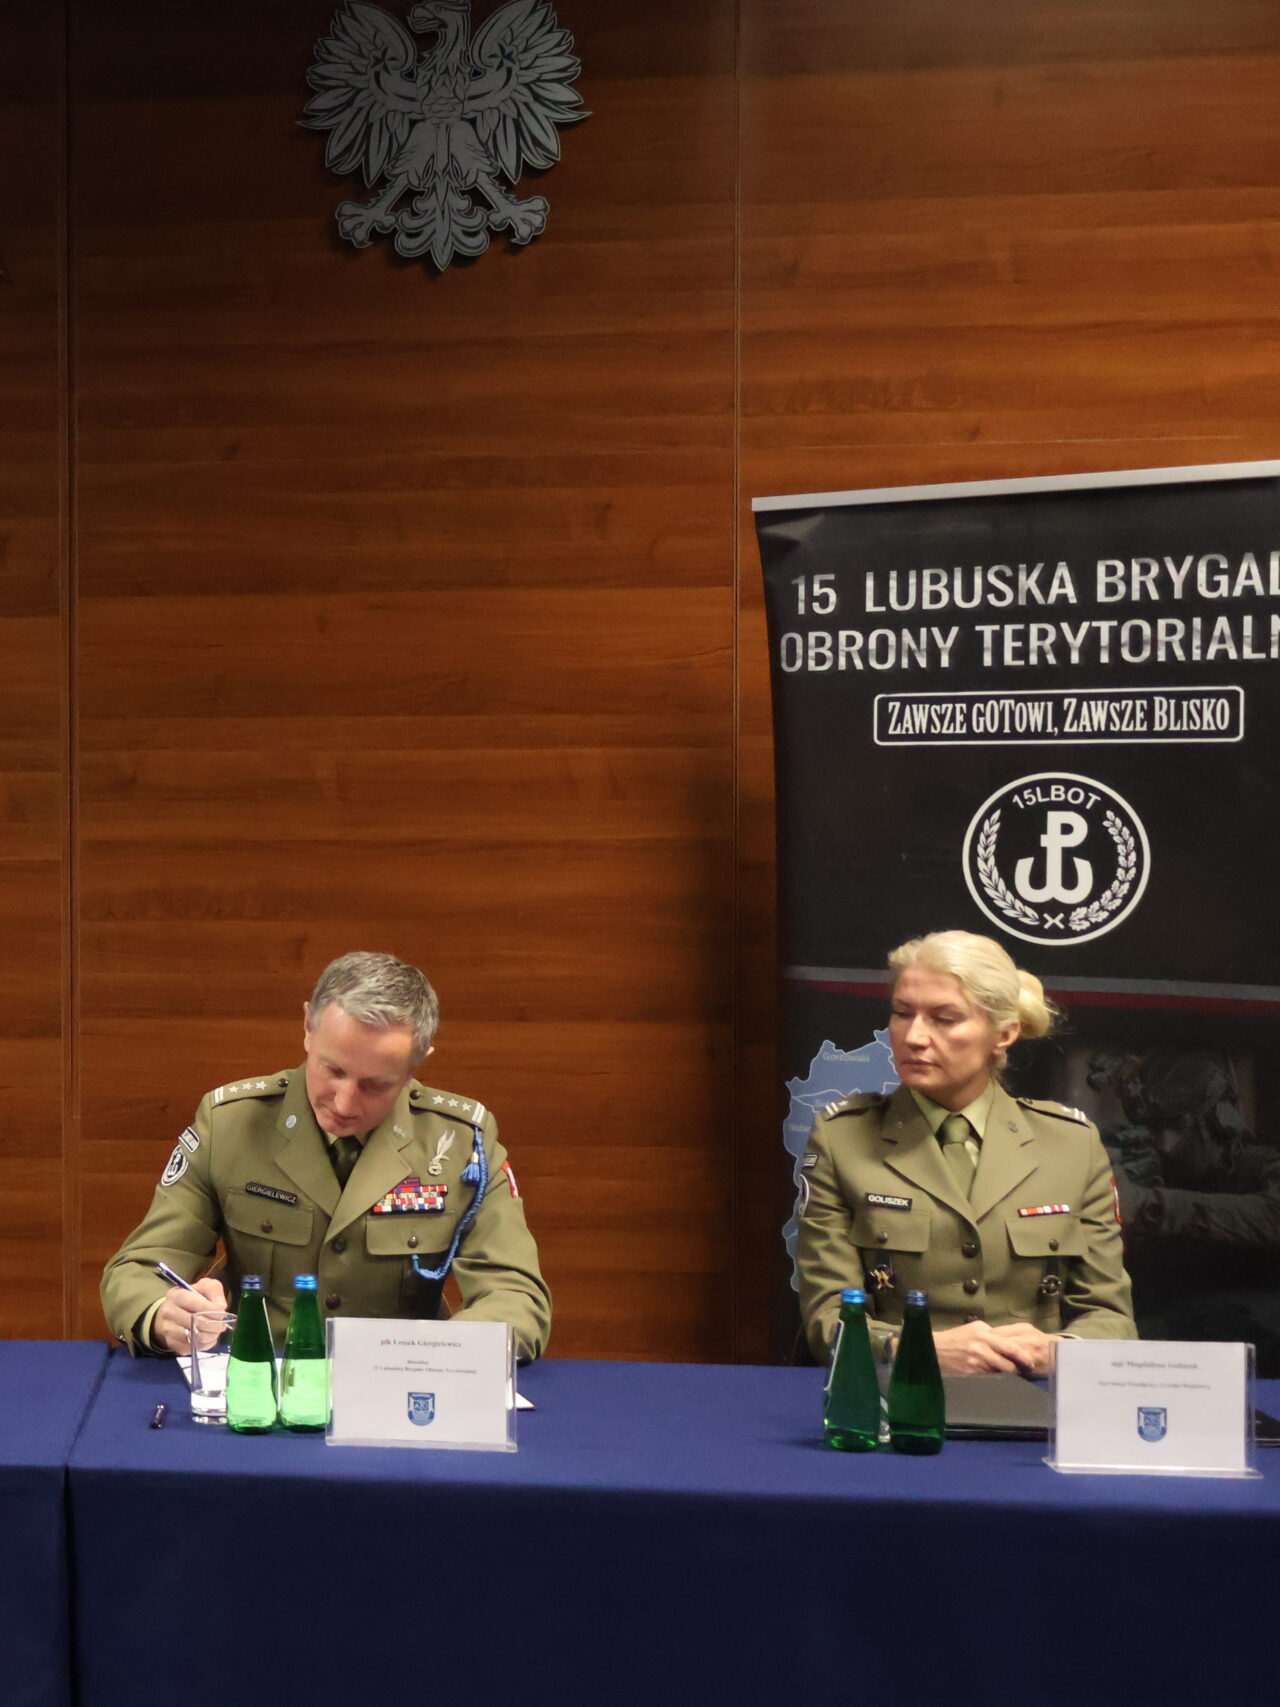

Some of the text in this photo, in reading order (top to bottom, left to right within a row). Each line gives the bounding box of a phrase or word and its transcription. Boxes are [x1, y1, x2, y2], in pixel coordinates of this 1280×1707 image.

[790, 573, 838, 615] 15
[865, 561, 1078, 613] LUBUSKA
[780, 625, 960, 673] OBRONY
[888, 701, 967, 735] ZAWSZE
[1063, 697, 1149, 733] ZAWSZE
[1153, 696, 1230, 731] BLISKO
[1012, 784, 1102, 810] 15LBOT
